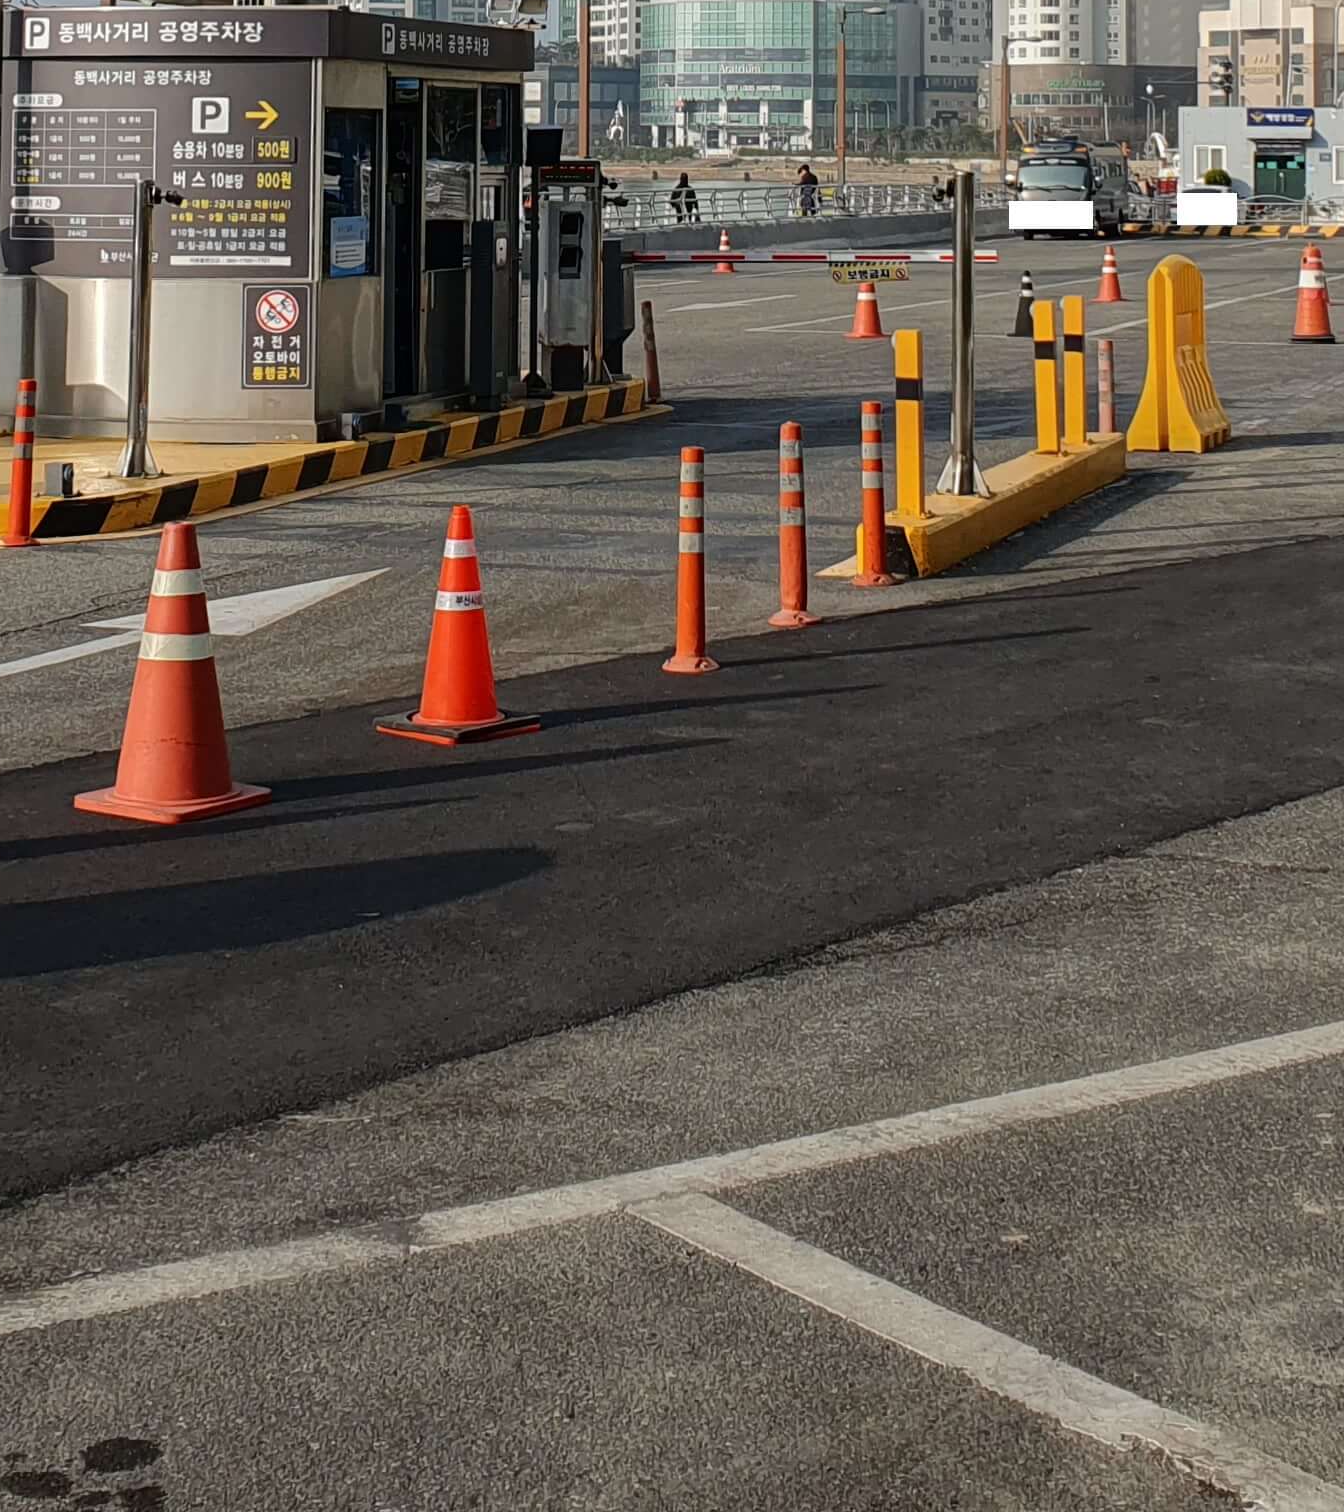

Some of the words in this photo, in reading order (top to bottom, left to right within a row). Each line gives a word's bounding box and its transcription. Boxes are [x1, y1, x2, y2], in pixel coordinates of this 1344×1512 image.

[58, 21, 149, 43] 동백사거리
[159, 20, 264, 43] 공영주차장
[399, 29, 443, 54] 동백사거리
[448, 34, 490, 57] 공영주차장
[74, 70, 136, 86] 동백사거리
[143, 69, 212, 86] 공영주차장
[172, 140, 207, 160] 승용차
[211, 141, 245, 159] 10분당
[257, 140, 289, 159] 500원
[211, 172, 244, 189] 10분당
[256, 171, 292, 189] 900원
[847, 269, 890, 279] 보행금지
[253, 351, 300, 364] 오토바이
[253, 366, 300, 381] 통행금지
